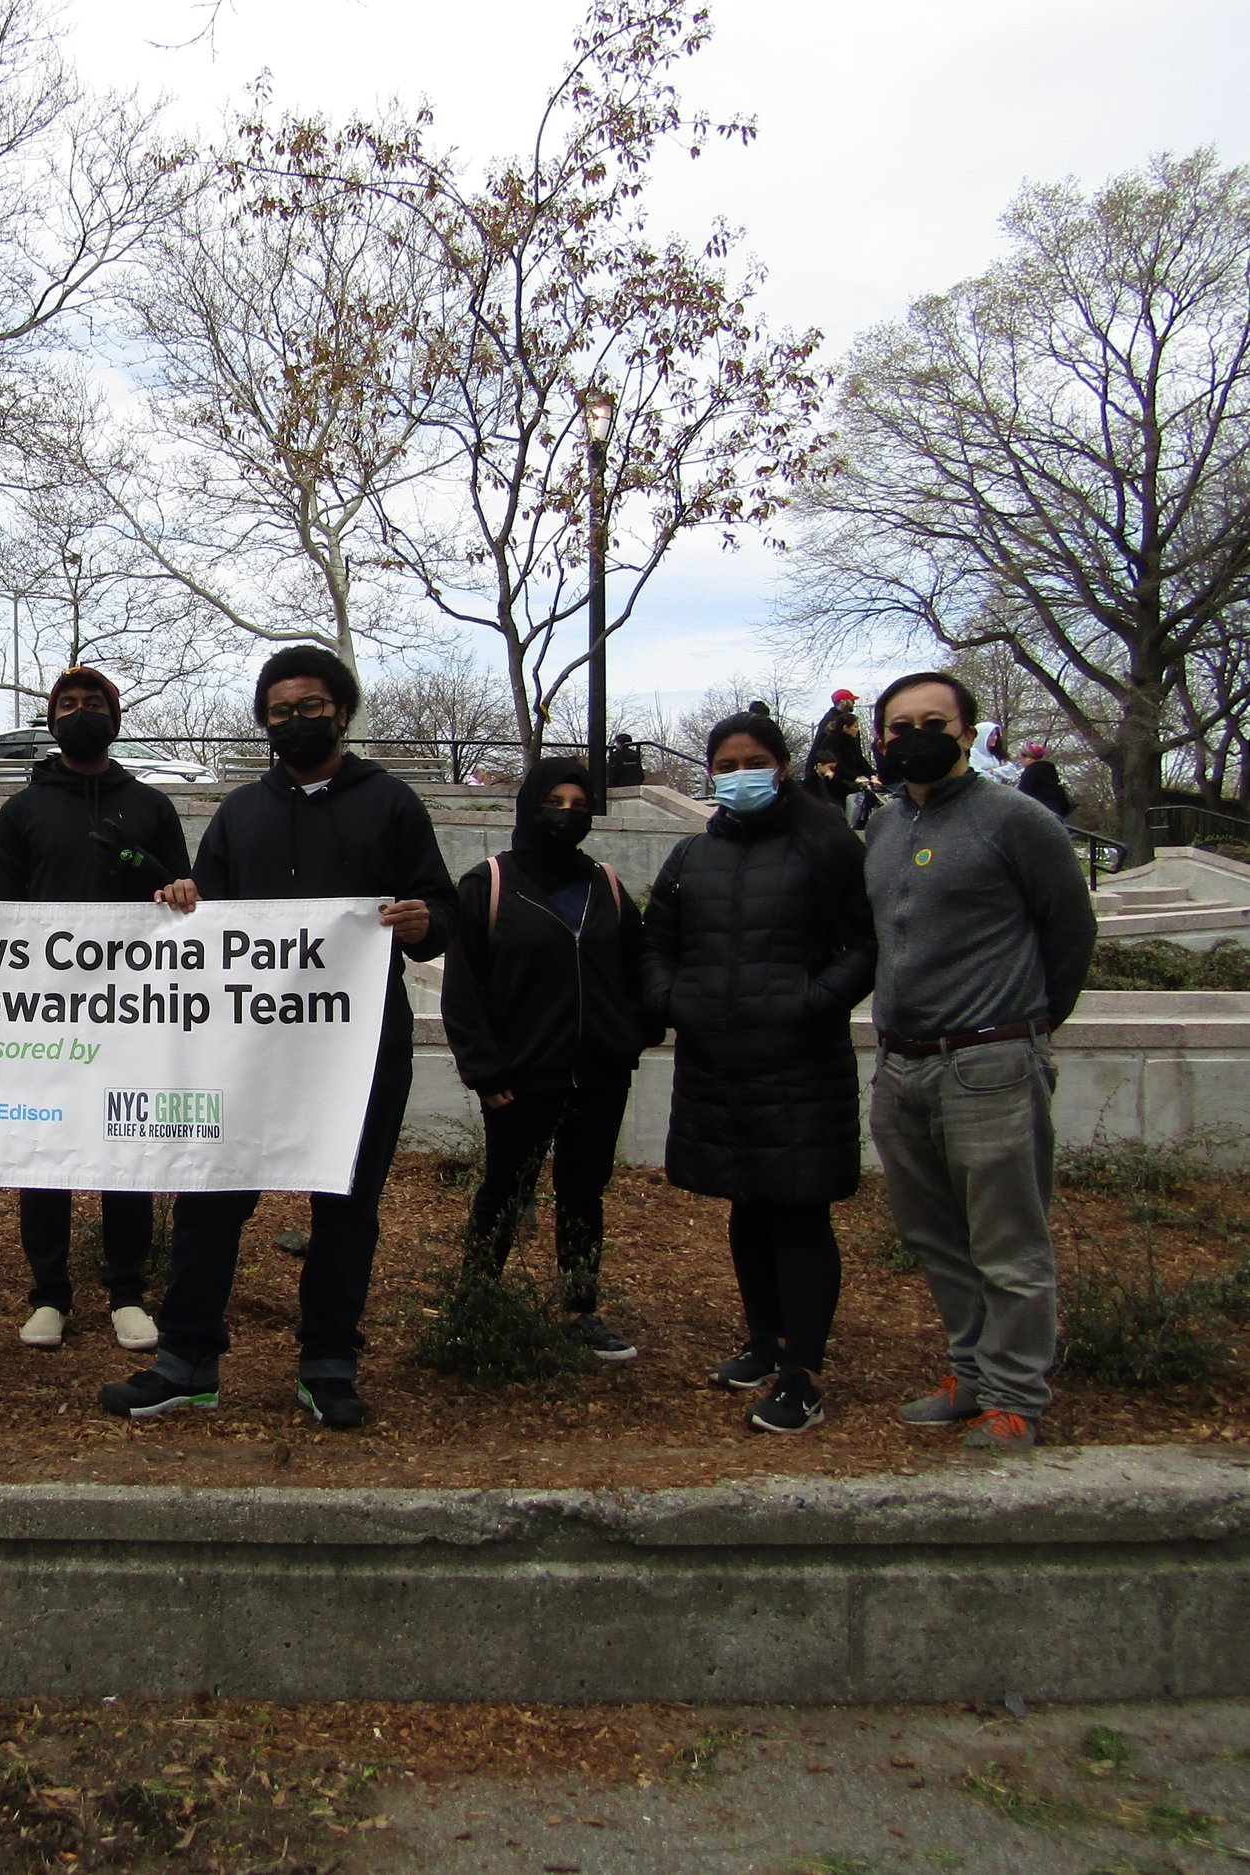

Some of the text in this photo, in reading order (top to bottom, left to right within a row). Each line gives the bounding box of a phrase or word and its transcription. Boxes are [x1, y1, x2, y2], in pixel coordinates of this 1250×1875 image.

[45, 930, 204, 971] Corona
[222, 928, 326, 970] Park
[224, 984, 351, 1024] Team
[69, 1038, 101, 1065] by
[107, 1091, 220, 1123] NYC GREEN
[107, 1123, 220, 1138] RELIEF & RECOVERY FUND
